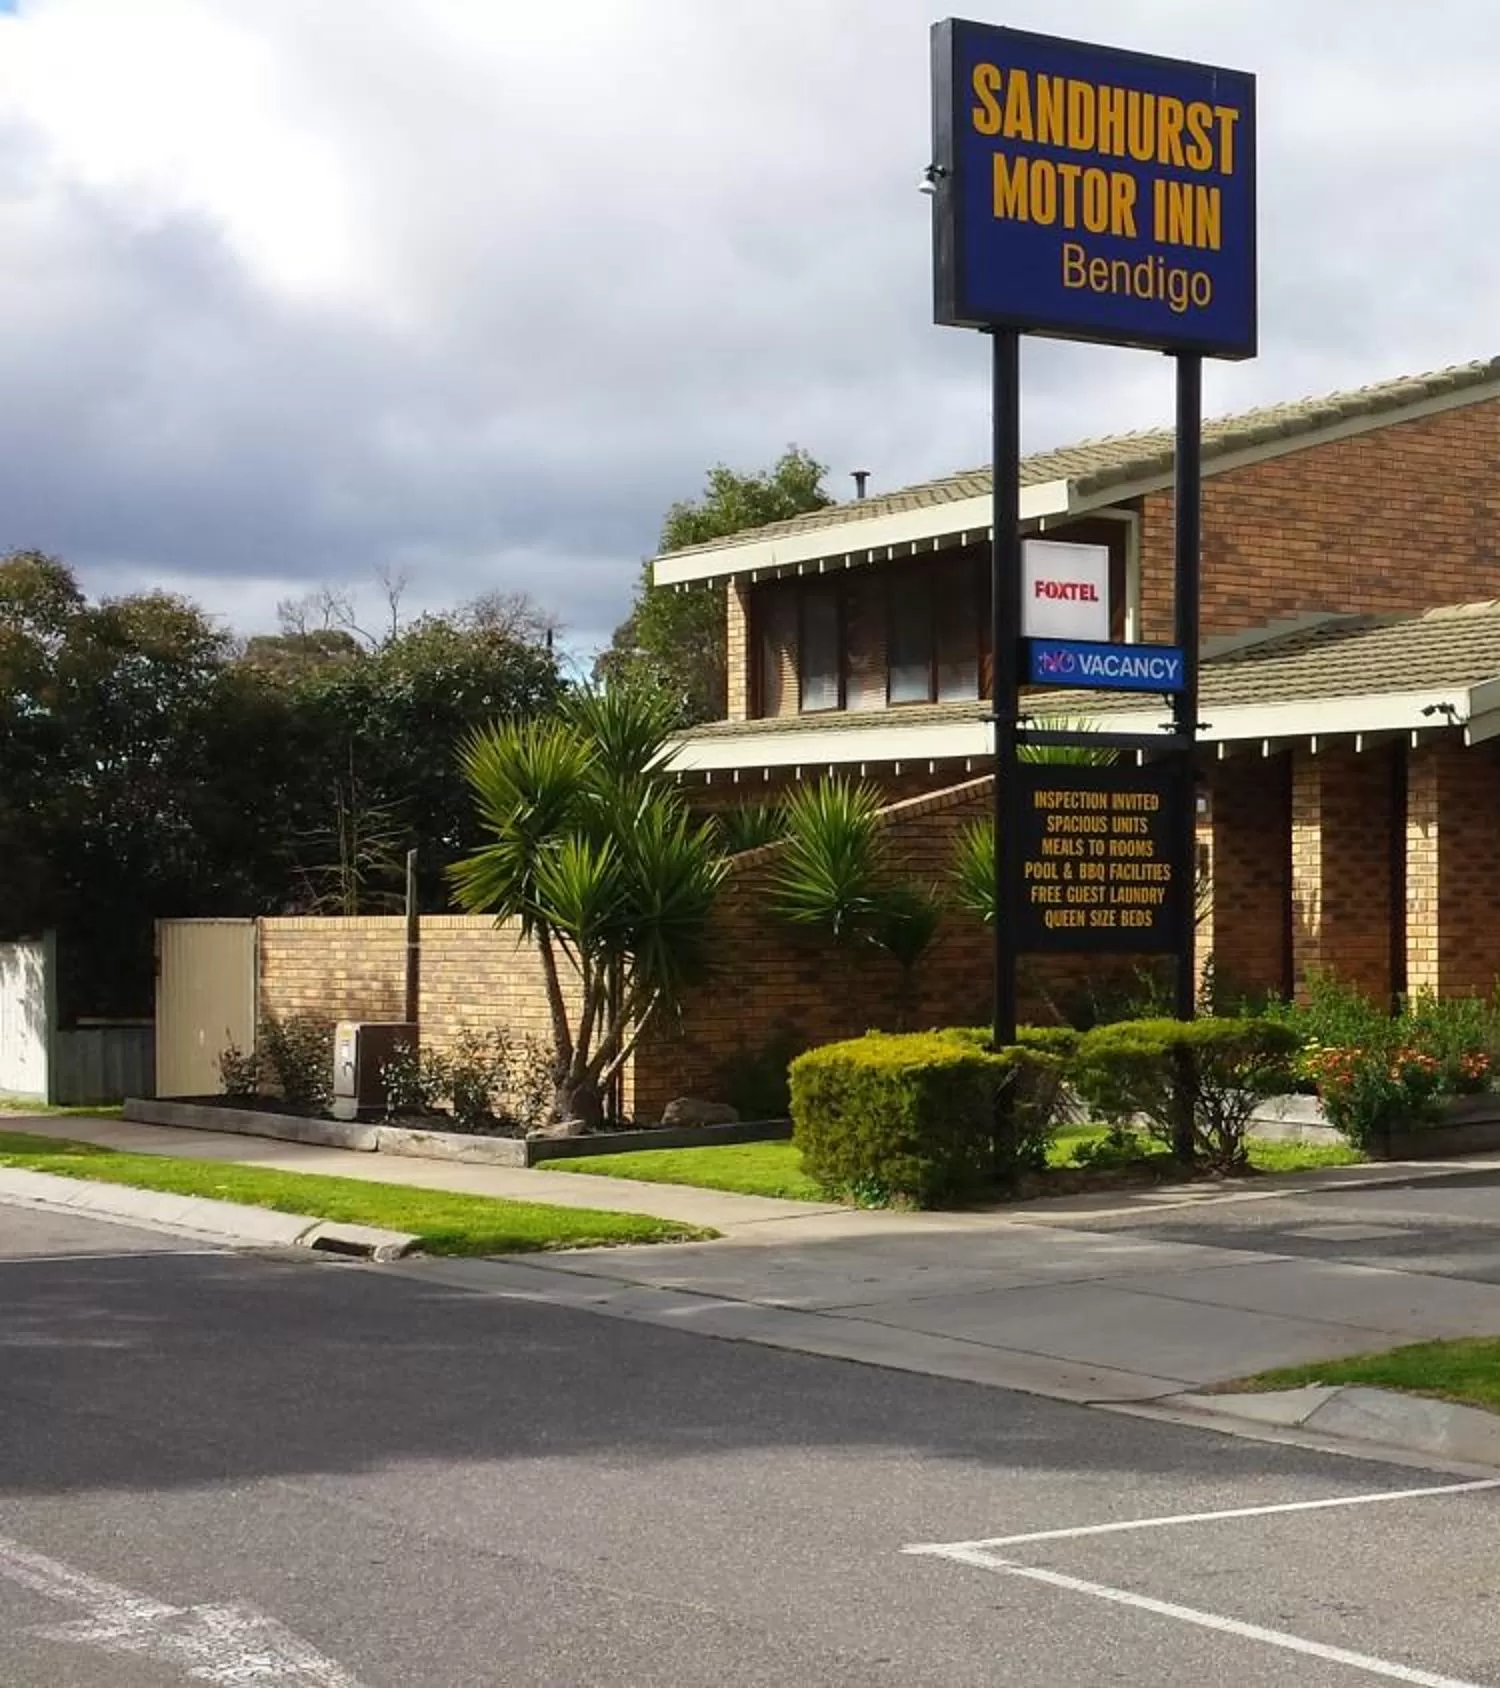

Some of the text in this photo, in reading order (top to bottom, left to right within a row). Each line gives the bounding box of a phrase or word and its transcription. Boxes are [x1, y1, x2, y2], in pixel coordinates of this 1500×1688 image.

[972, 63, 1239, 175] SANDHURST
[993, 152, 1221, 250] MOTOR INN
[1063, 243, 1212, 313] Bendigo
[1034, 580, 1099, 602] FOXTEL
[1078, 653, 1178, 679] VACANCY
[1034, 792, 1159, 810] INSPECTION INVITED
[1047, 815, 1148, 833] SPACIOUS UNITS
[1042, 839, 1153, 857] MEALS TO ROOMS
[1025, 862, 1171, 882] POOL & BBQ FACILITIES
[1031, 886, 1165, 904] FREE GUEST LAUNDRY
[1045, 910, 1152, 928] QUEEN SIZE BEDS
